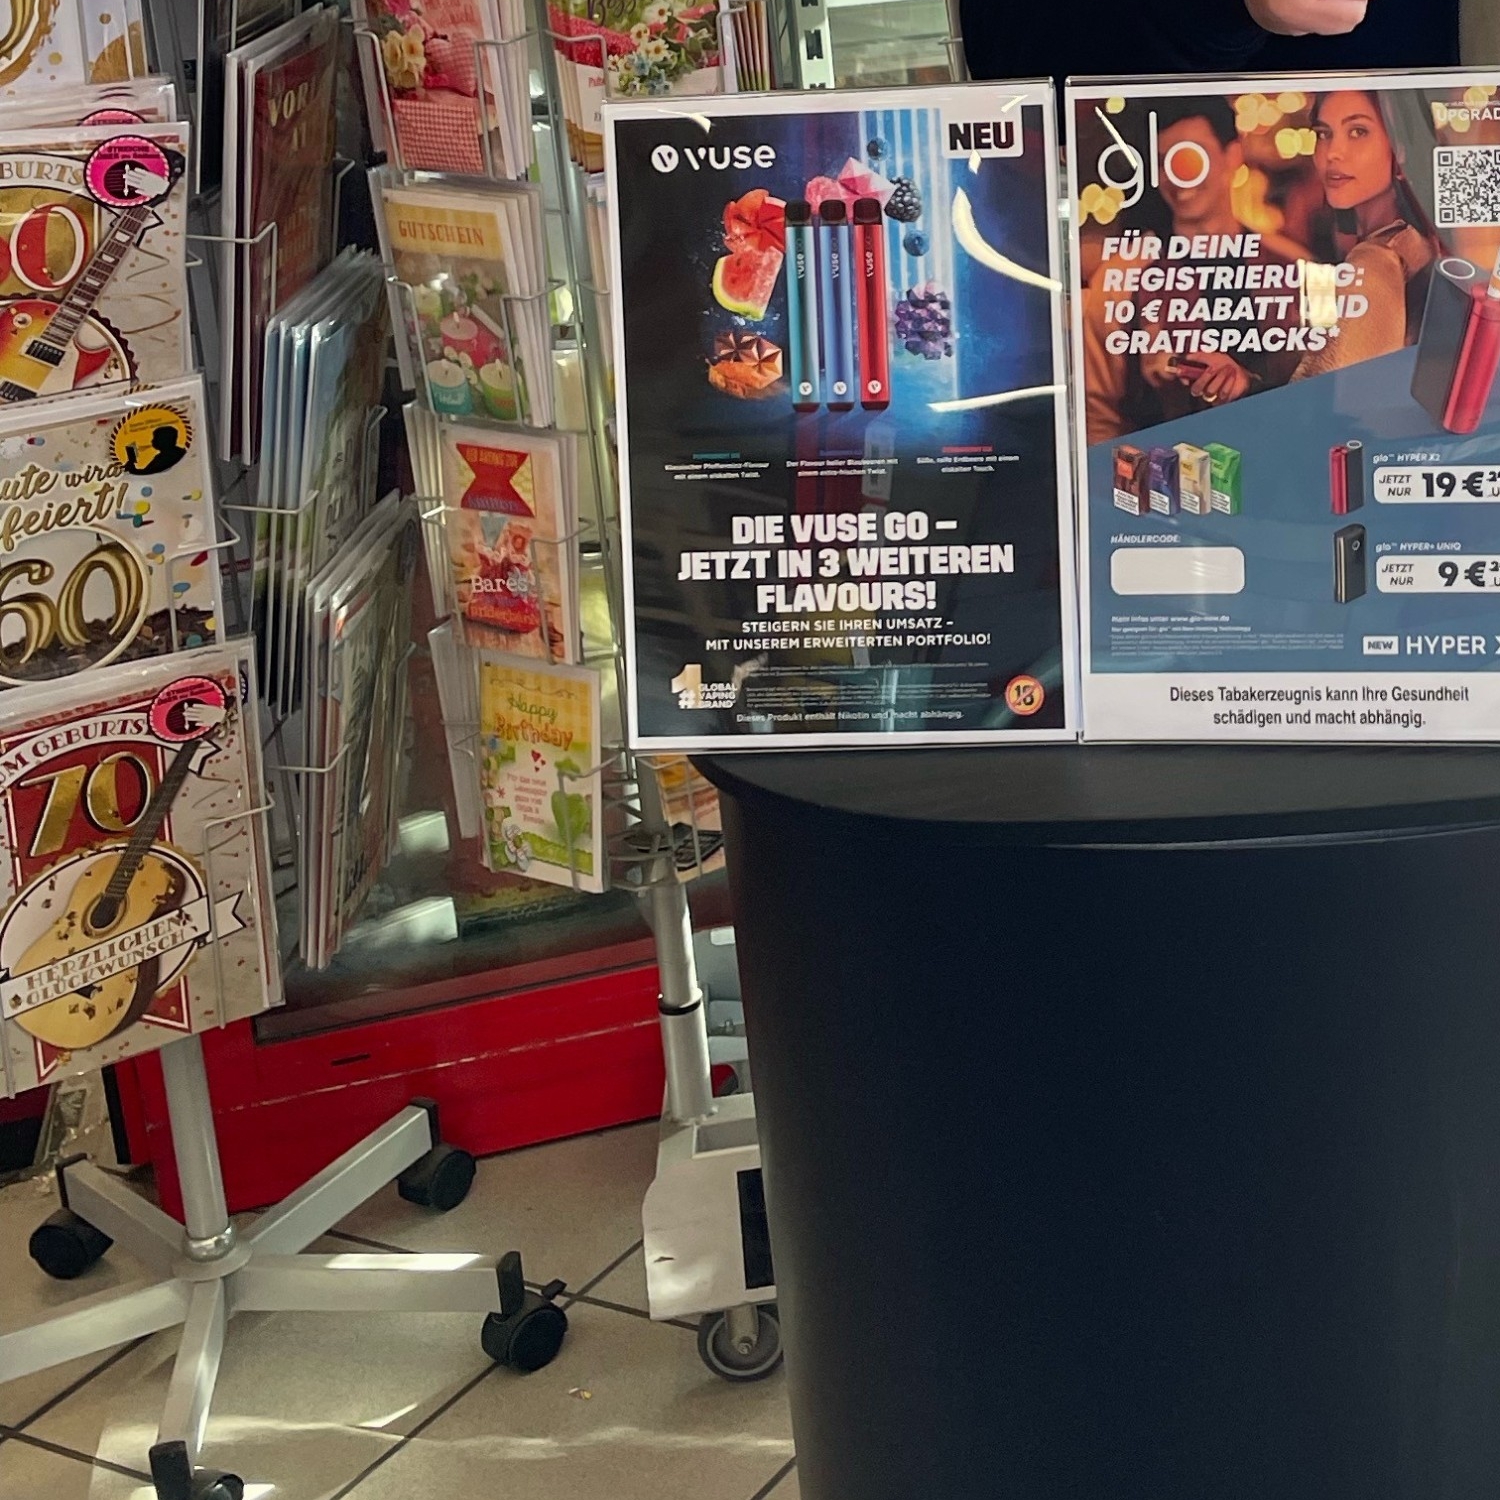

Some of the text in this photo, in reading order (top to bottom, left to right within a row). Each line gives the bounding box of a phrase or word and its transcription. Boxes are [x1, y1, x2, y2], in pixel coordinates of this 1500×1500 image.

[948, 121, 1015, 151] NEU
[1097, 110, 1211, 210] glo
[0, 161, 84, 186] BURTS
[398, 220, 485, 246] GUTSCHEIN
[1102, 230, 1262, 261] FÜR DEINE
[1103, 262, 1365, 293] REGISTRIERUNG:
[1104, 294, 1370, 324] 10 € RABATT UND
[1396, 452, 1441, 463] HYPER X2
[1379, 474, 1412, 485] JETZT
[1387, 486, 1411, 497] NUR
[1421, 471, 1485, 499] 19 €
[0, 482, 129, 552] feiert!
[732, 514, 785, 545] DIE
[790, 512, 878, 544] VUSE
[884, 511, 930, 541] GO
[1110, 532, 1181, 546] HÄNDLERCODE:
[1436, 542, 1462, 552] UNIQ
[677, 544, 1015, 581] JETZT IN 3 WEITEREN
[1381, 563, 1414, 574] JETZT
[1438, 560, 1487, 588] 9 €
[471, 575, 529, 595] Bares
[1389, 576, 1414, 586] NUR
[0, 540, 145, 665] 60
[756, 581, 938, 614] FLAVOURS!
[741, 617, 943, 634] STEIGERN SIE IHREN UMSATZ
[705, 633, 993, 651] MIT UNSEREM ERWEITERTEN PORTFOLIO!
[1367, 640, 1395, 651] NEW
[1405, 635, 1487, 656] HYPER
[698, 682, 738, 692] GLOBAL
[699, 691, 736, 700] VAPING
[1169, 685, 1470, 705] Dieses Tabakerzeugnis kann Ihre Gesundheit
[507, 693, 558, 724] Happy
[736, 709, 965, 723] Dieses Produkt enthält Nikotin und macht abhängig.
[1213, 708, 1428, 729] schädigen und macht abhängig.
[30, 717, 145, 758] GEBURTS
[493, 713, 574, 751] Birthday
[19, 750, 153, 858] 70
[25, 915, 188, 991] HERZLICHEN
